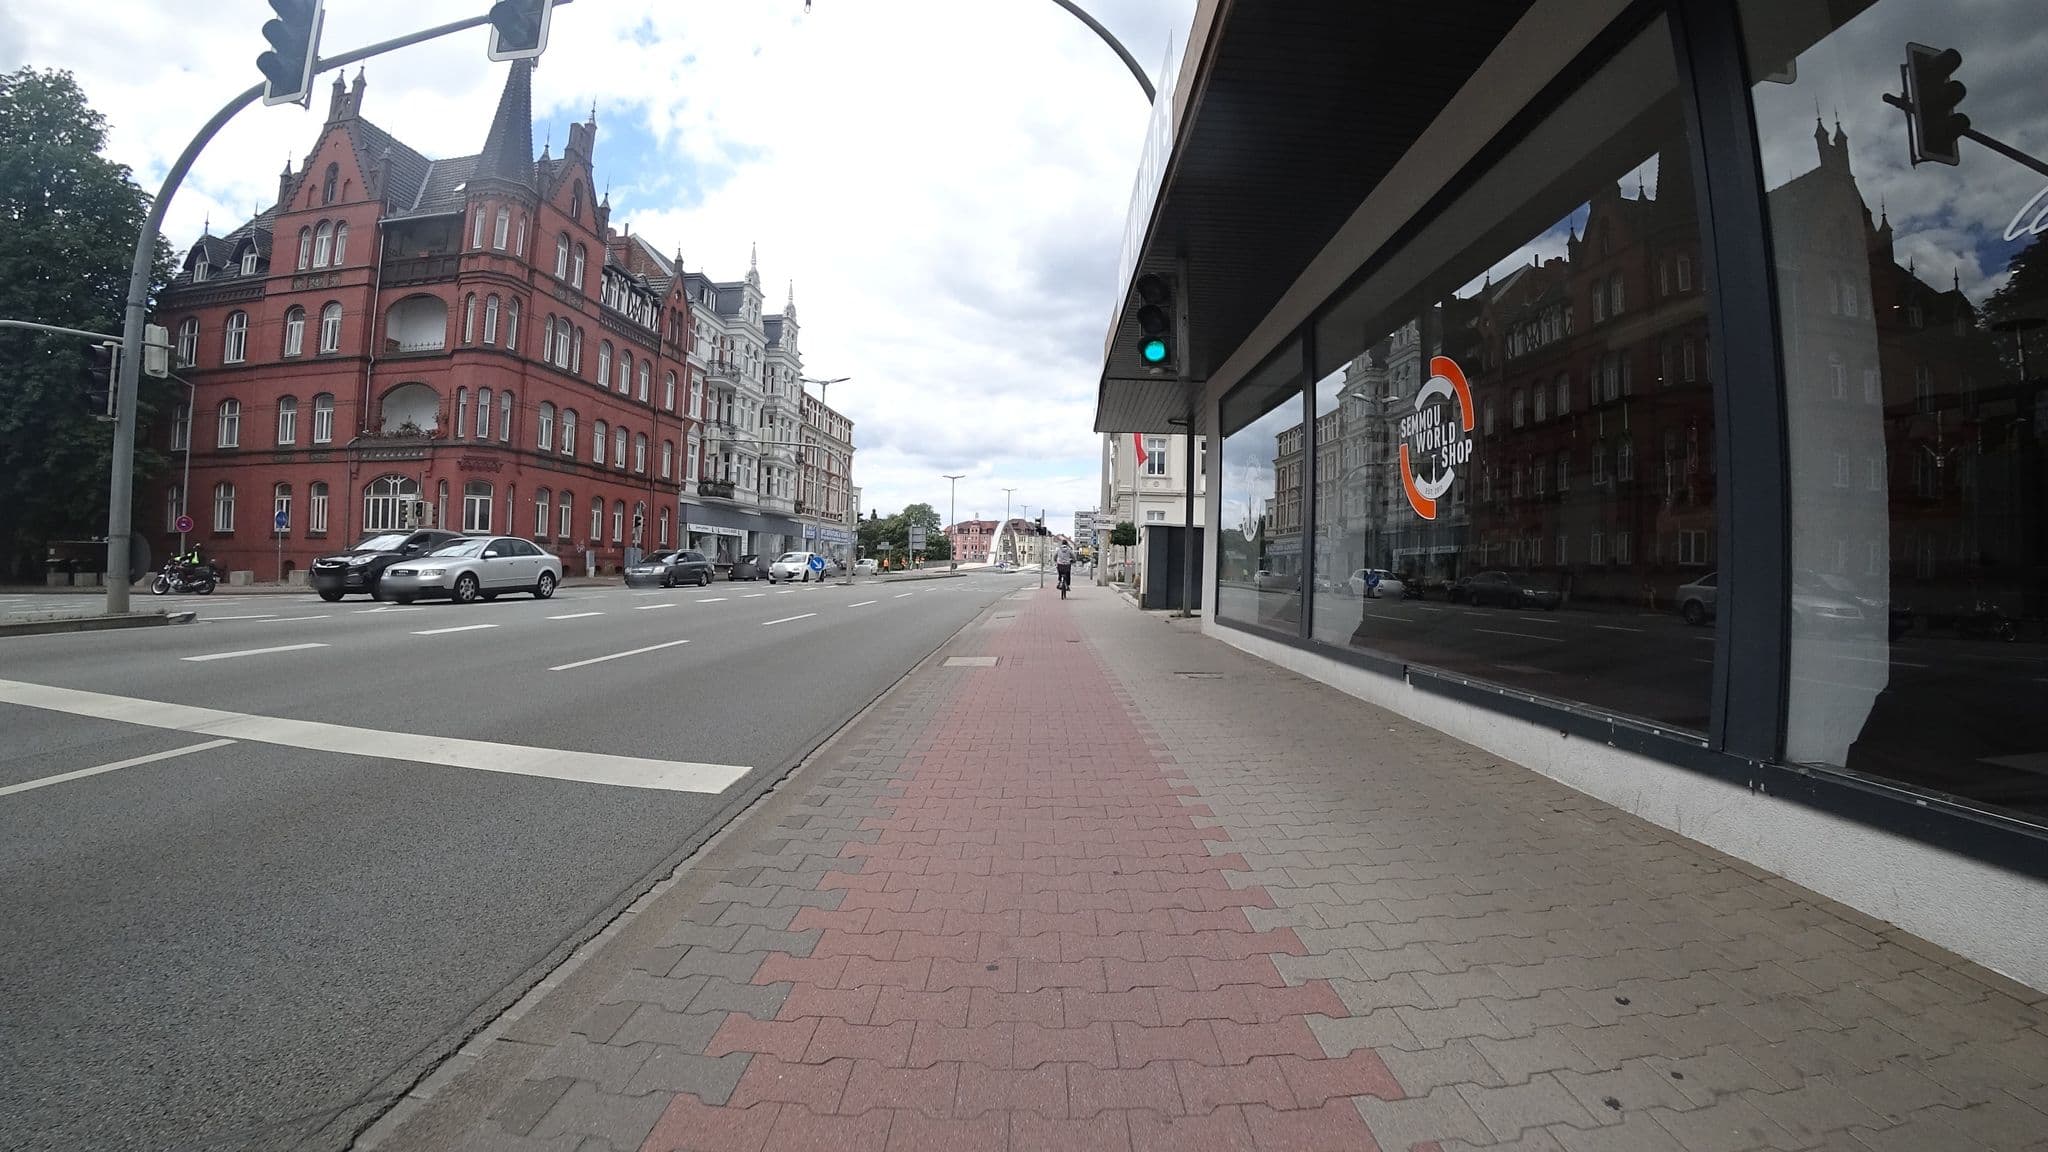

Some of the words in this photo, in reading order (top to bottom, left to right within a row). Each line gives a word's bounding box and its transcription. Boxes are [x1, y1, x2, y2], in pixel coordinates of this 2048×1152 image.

[1401, 404, 1441, 438] SEMMOU
[1416, 421, 1456, 454] WORLD
[1441, 438, 1473, 468] SHOP
